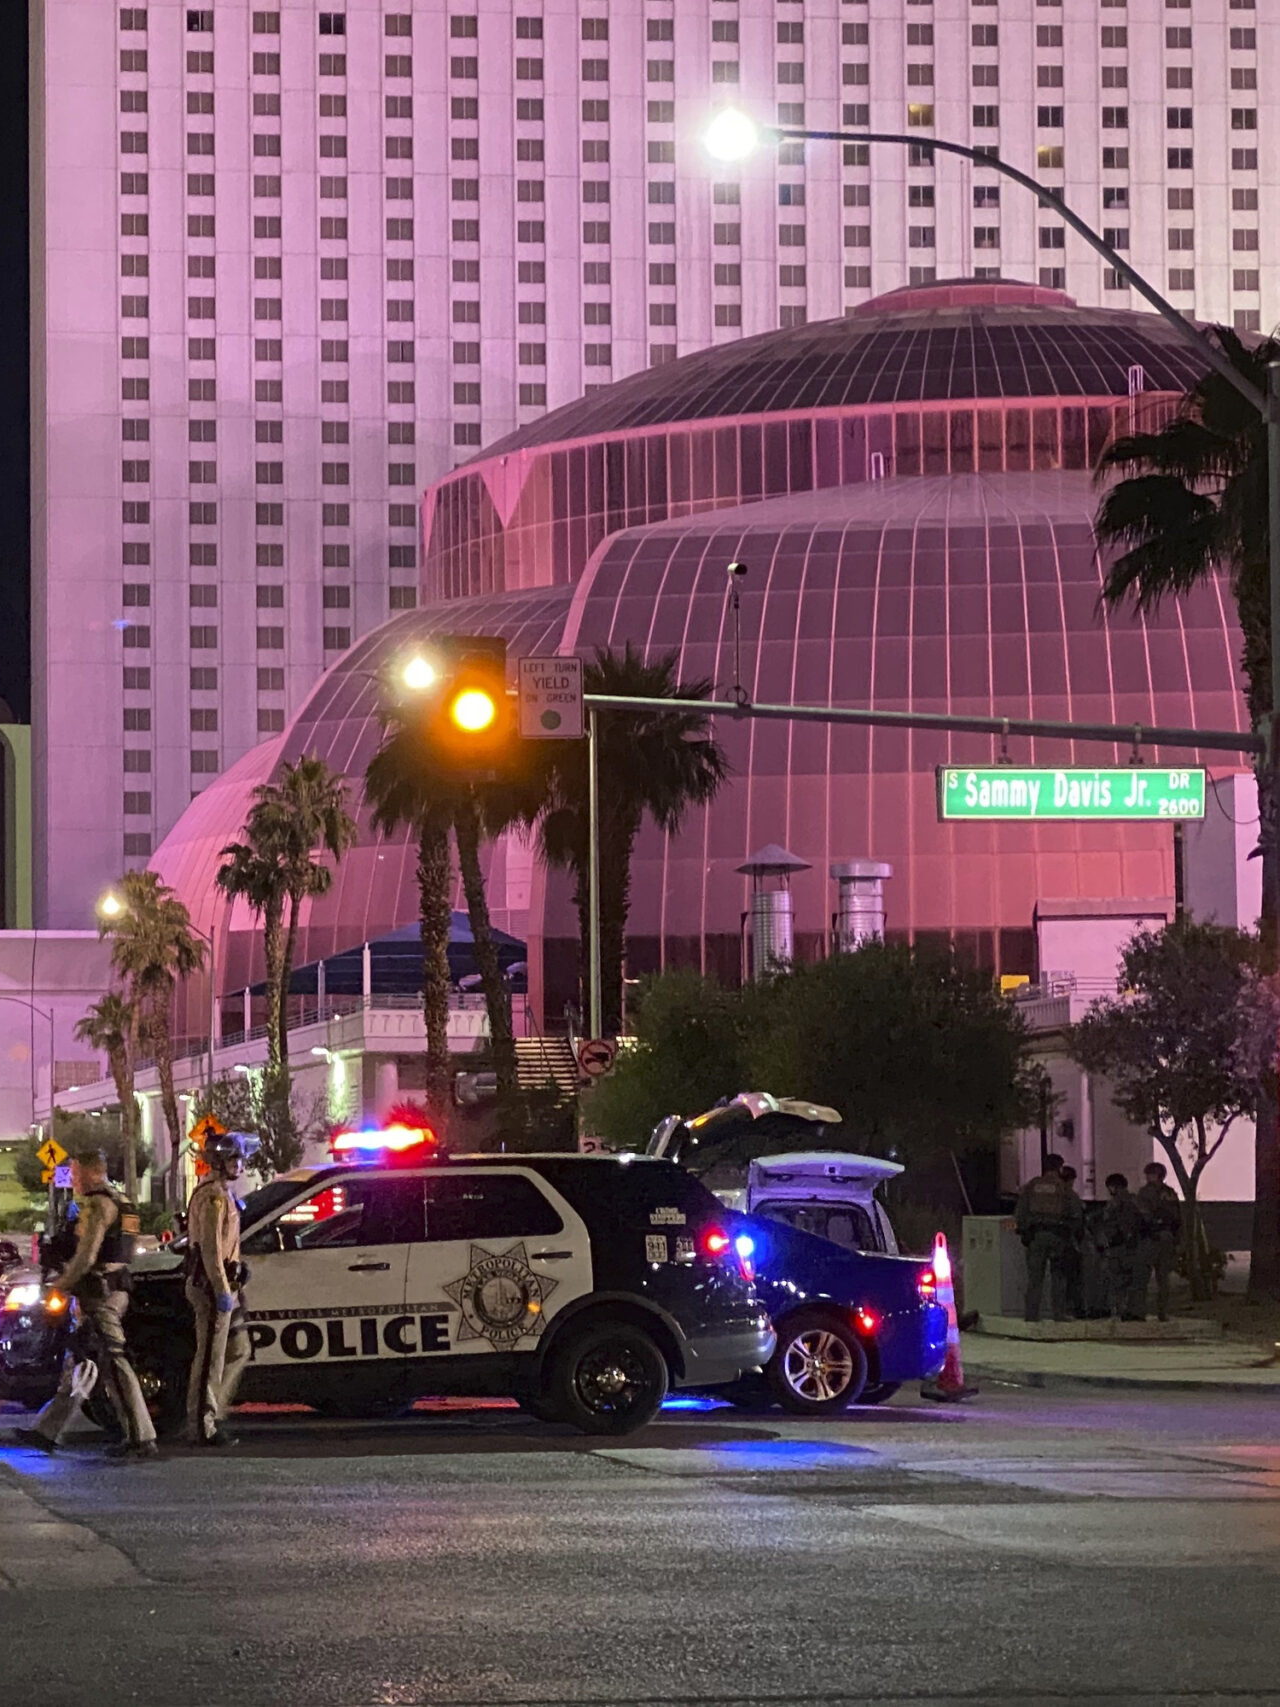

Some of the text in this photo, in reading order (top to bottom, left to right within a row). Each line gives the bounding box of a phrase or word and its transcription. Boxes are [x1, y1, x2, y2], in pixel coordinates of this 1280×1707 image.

[523, 663, 577, 673] LEFT TURN
[533, 676, 570, 690] YIELD
[546, 693, 576, 703] GREEN
[948, 772, 1190, 815] S Sammy Davis Jr. DR
[1158, 798, 1200, 816] 2600
[247, 1314, 451, 1361] POLICE
